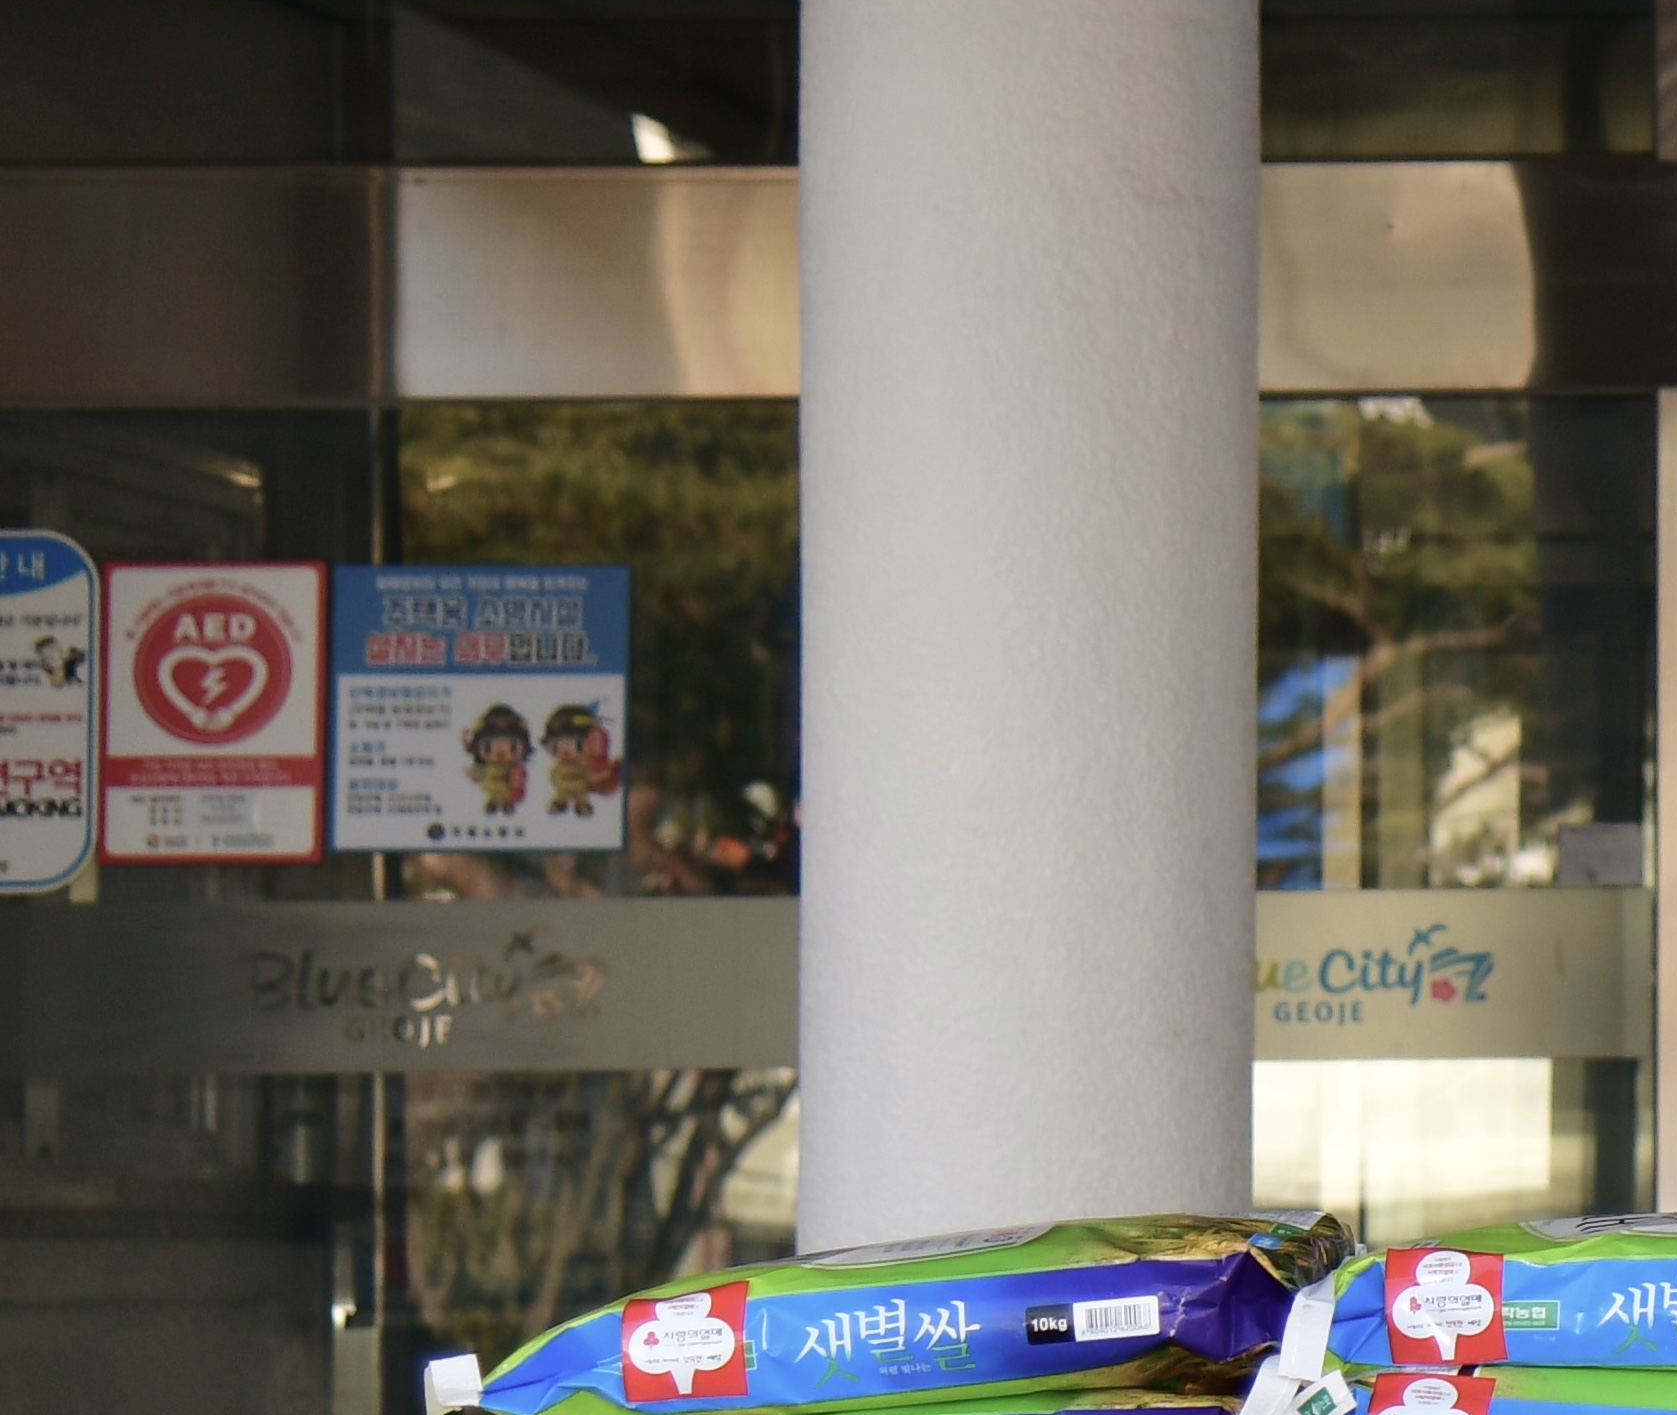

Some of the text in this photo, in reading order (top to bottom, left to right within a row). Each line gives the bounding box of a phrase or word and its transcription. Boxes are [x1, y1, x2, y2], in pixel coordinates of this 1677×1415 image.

[173, 612, 256, 641] AED
[1274, 1000, 1364, 1026] GEOJE
[1031, 1314, 1068, 1333] 10kg
